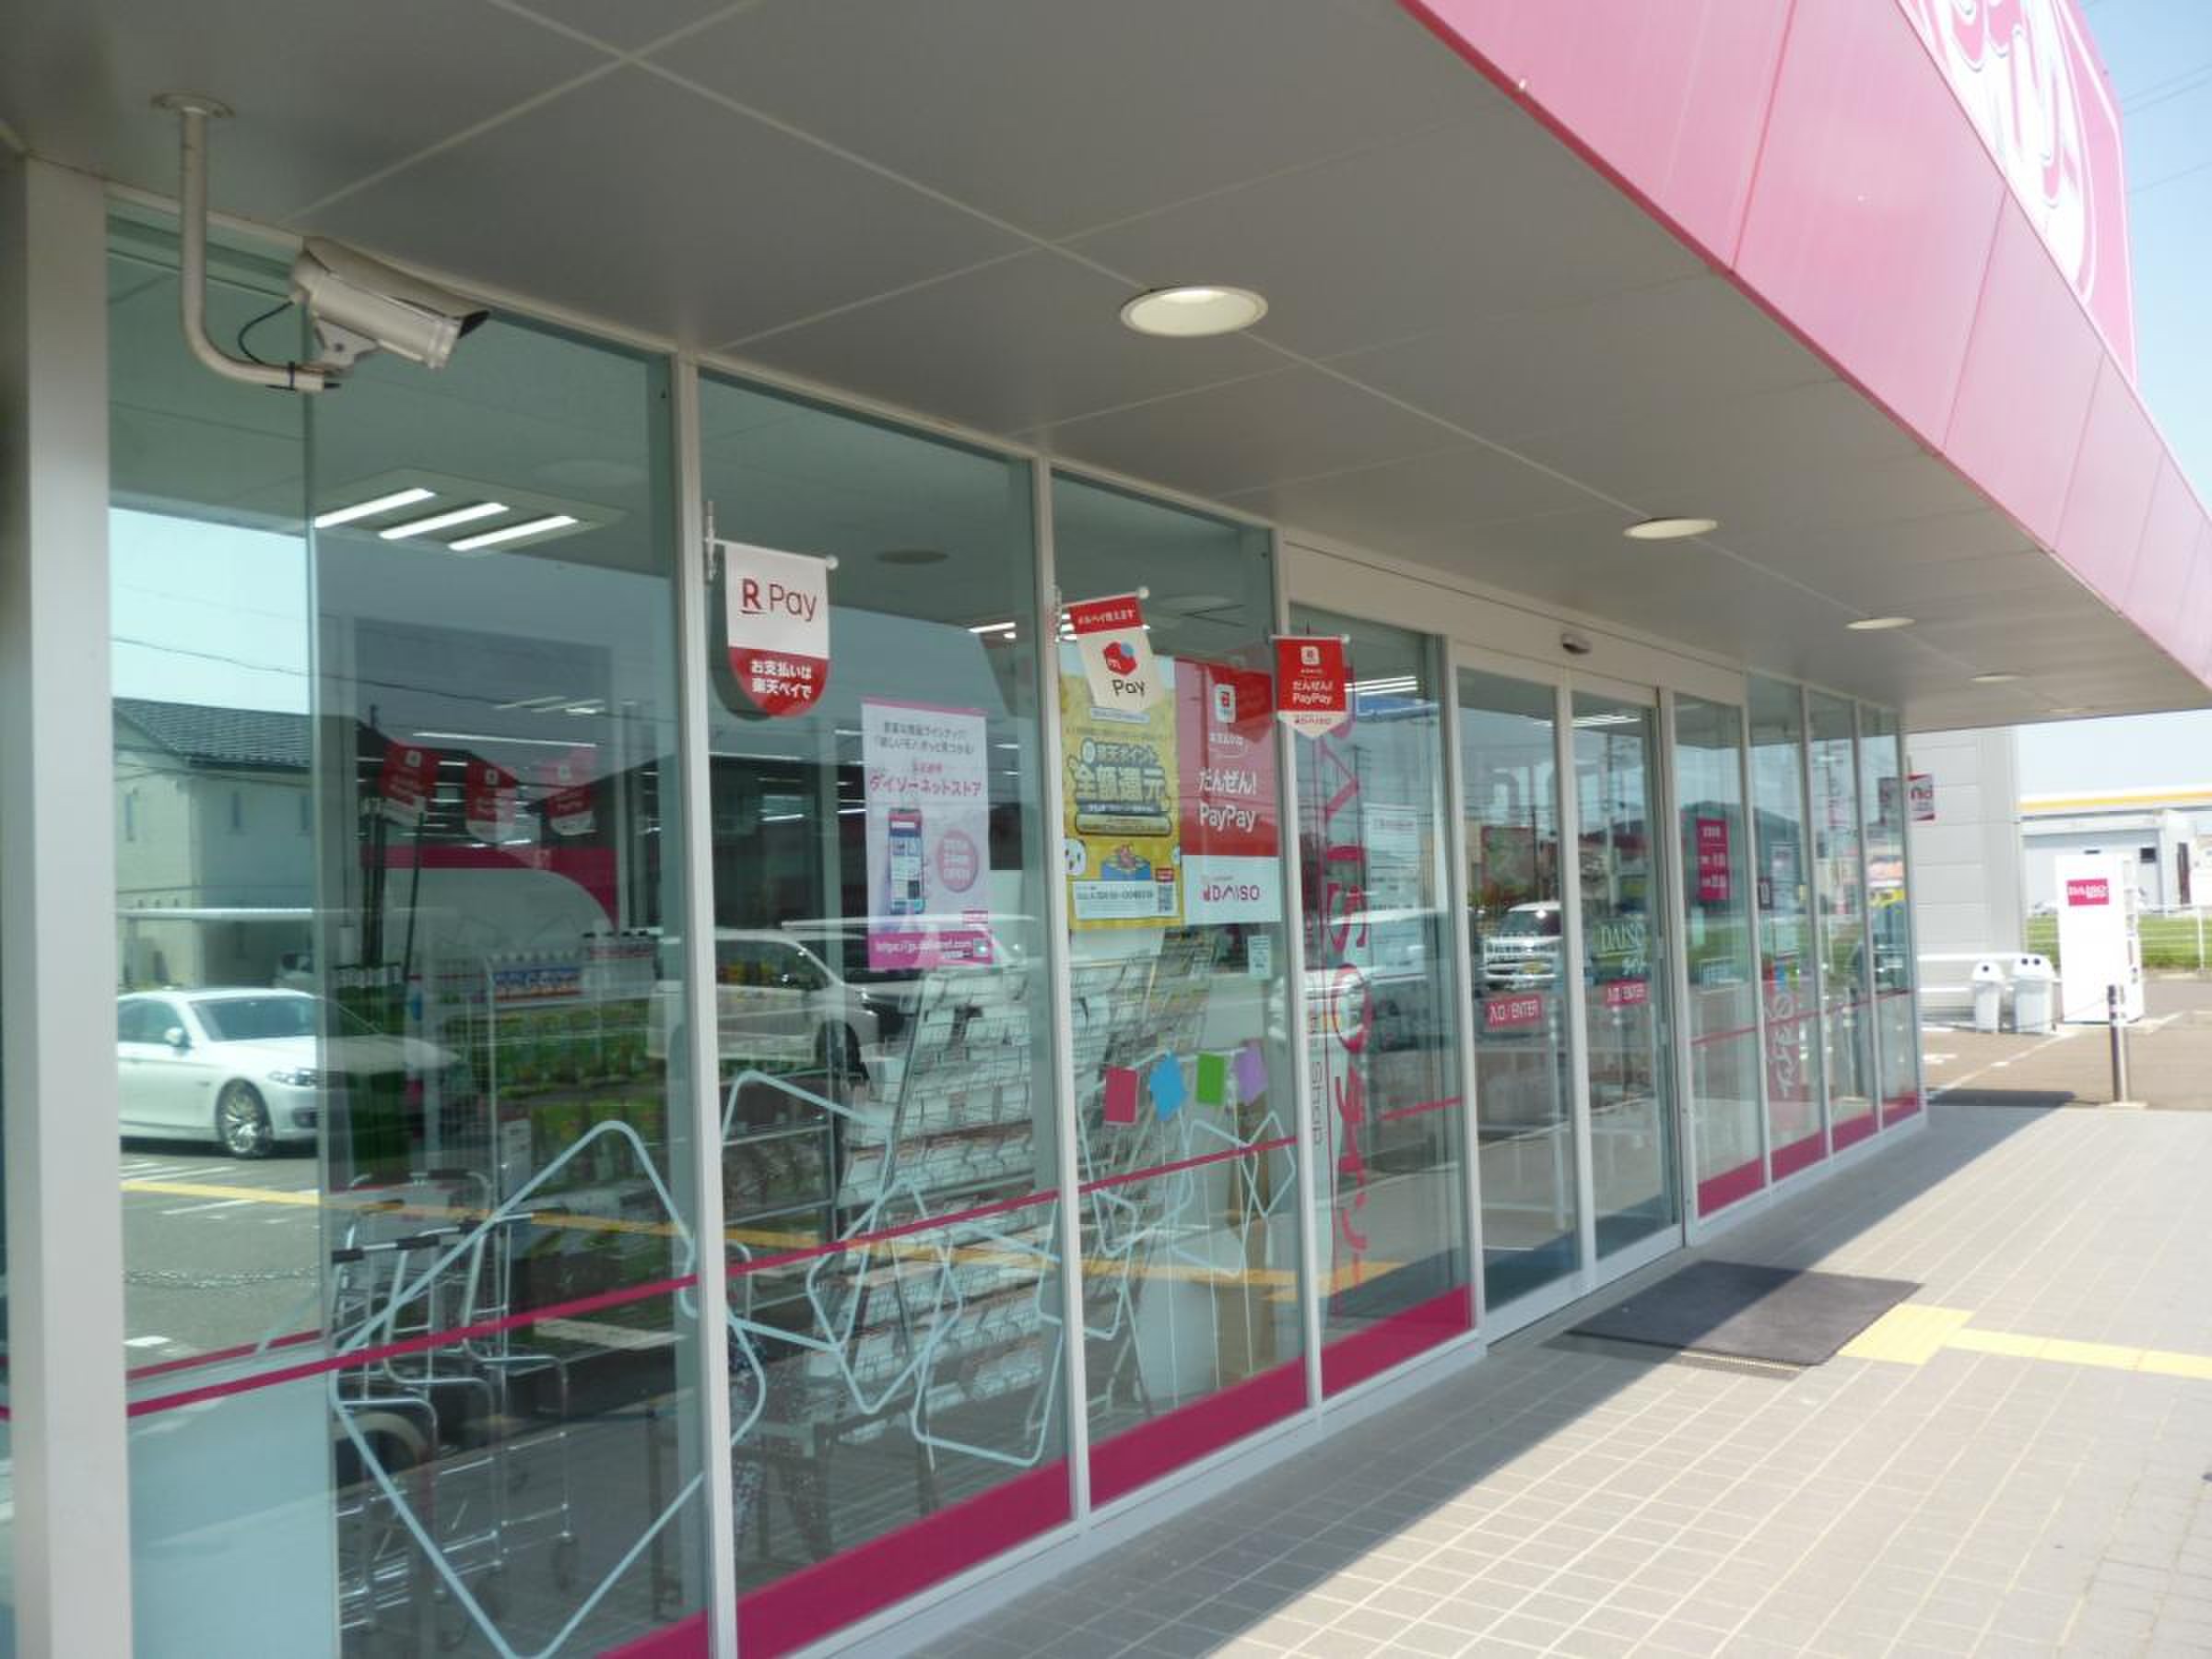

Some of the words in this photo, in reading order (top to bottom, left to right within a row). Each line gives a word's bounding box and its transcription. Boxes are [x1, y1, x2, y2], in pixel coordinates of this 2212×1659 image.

[769, 583, 818, 623] Pay
[1112, 678, 1146, 697] Pay
[1292, 692, 1333, 705] PayPay
[868, 769, 982, 797] ダイソーネットストア
[1199, 800, 1256, 832] PayPay
